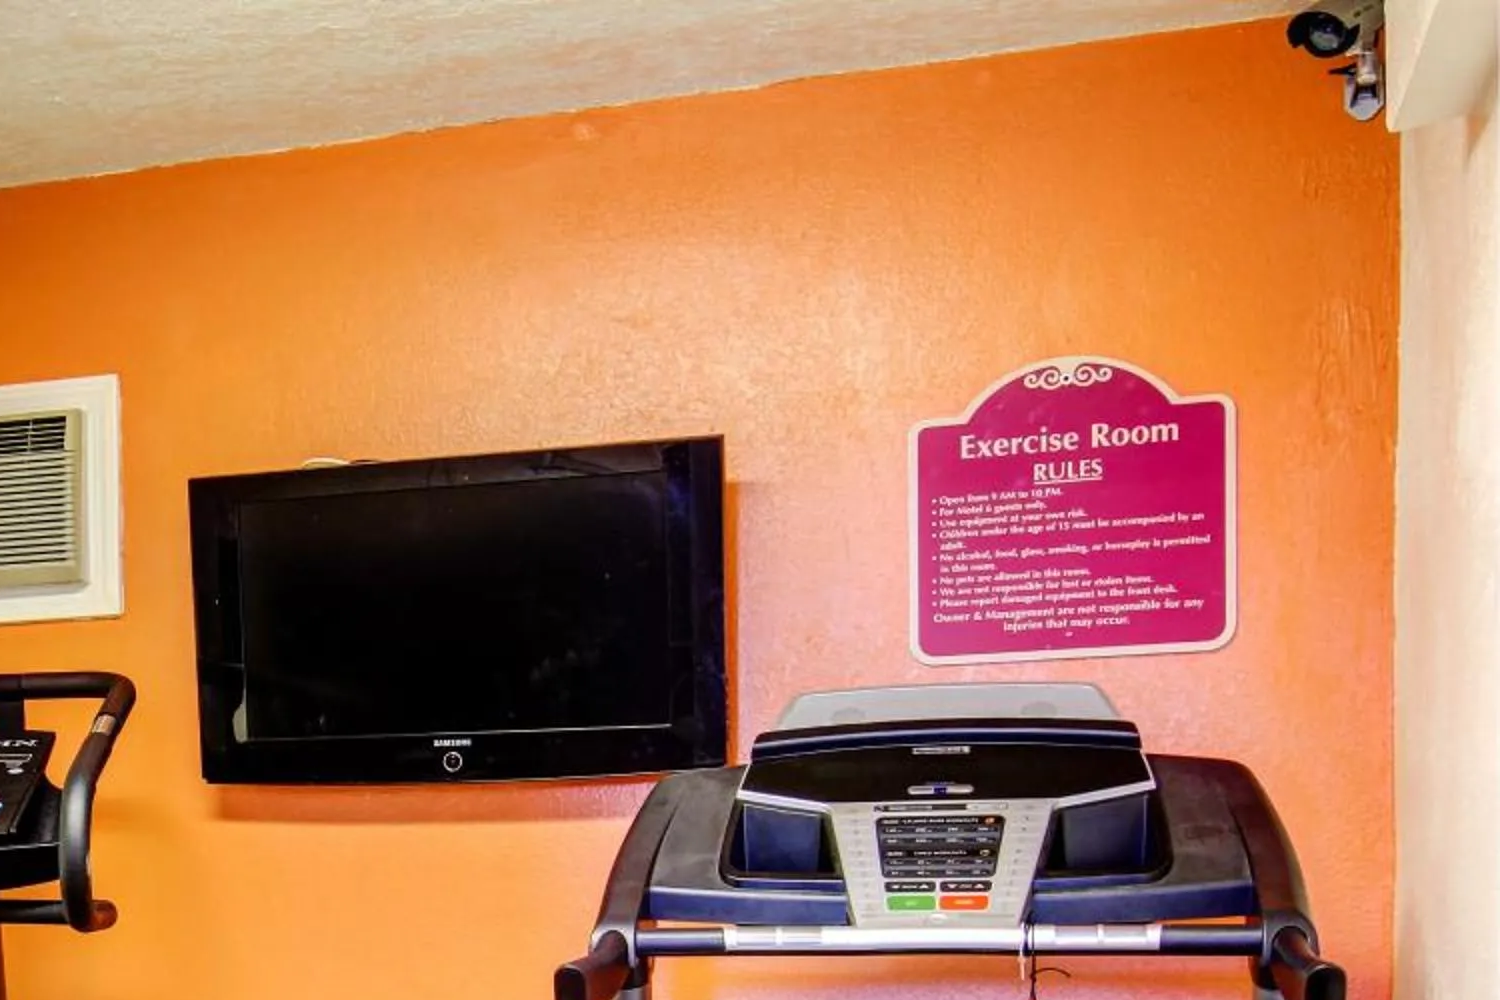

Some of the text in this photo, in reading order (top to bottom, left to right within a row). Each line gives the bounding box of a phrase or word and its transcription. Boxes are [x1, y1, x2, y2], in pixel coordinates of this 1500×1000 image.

[960, 422, 1179, 459] Exercise Room
[1033, 458, 1103, 481] RULES
[1031, 489, 1043, 498] 10
[933, 613, 971, 623] Owner
[984, 607, 1055, 622] Management
[1057, 607, 1075, 615] are
[1077, 604, 1096, 614] not
[1099, 599, 1161, 614] responsible
[1164, 597, 1180, 608] for
[1045, 618, 1068, 629] that
